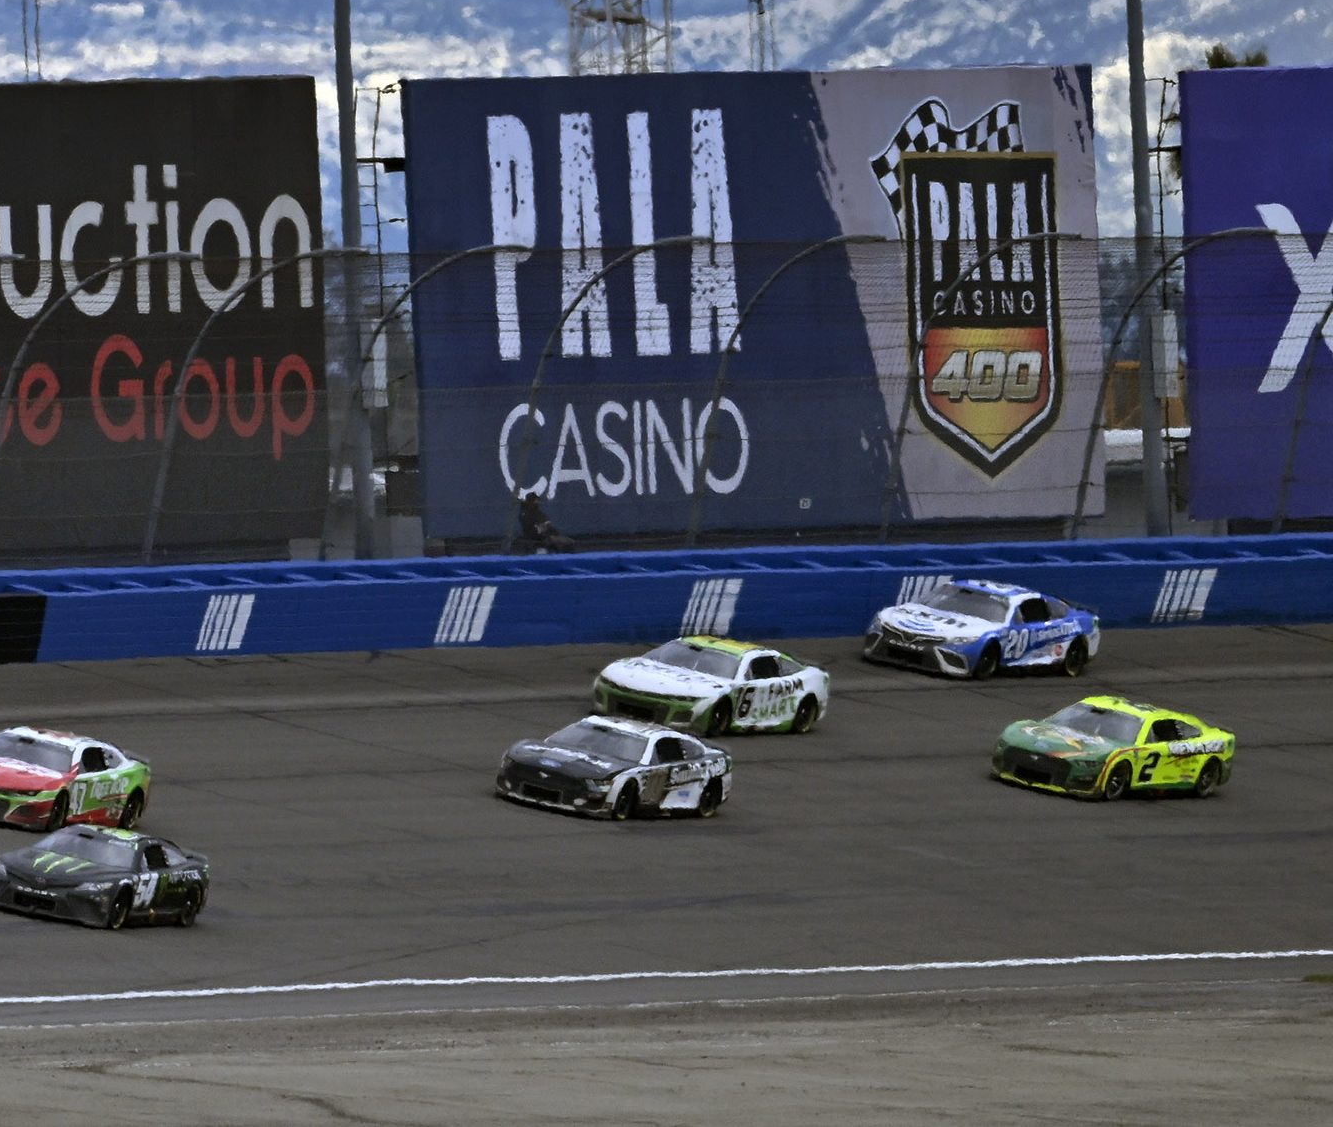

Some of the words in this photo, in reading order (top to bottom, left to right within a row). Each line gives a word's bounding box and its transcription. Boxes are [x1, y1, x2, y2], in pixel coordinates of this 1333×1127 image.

[487, 108, 741, 361] PALA
[929, 181, 1034, 282] PALA
[933, 290, 1036, 315] CASINO
[90, 333, 316, 461] Group
[932, 350, 1044, 403] 400
[499, 396, 750, 501] CASINO
[1005, 629, 1029, 659] 20
[1138, 752, 1161, 782] 2
